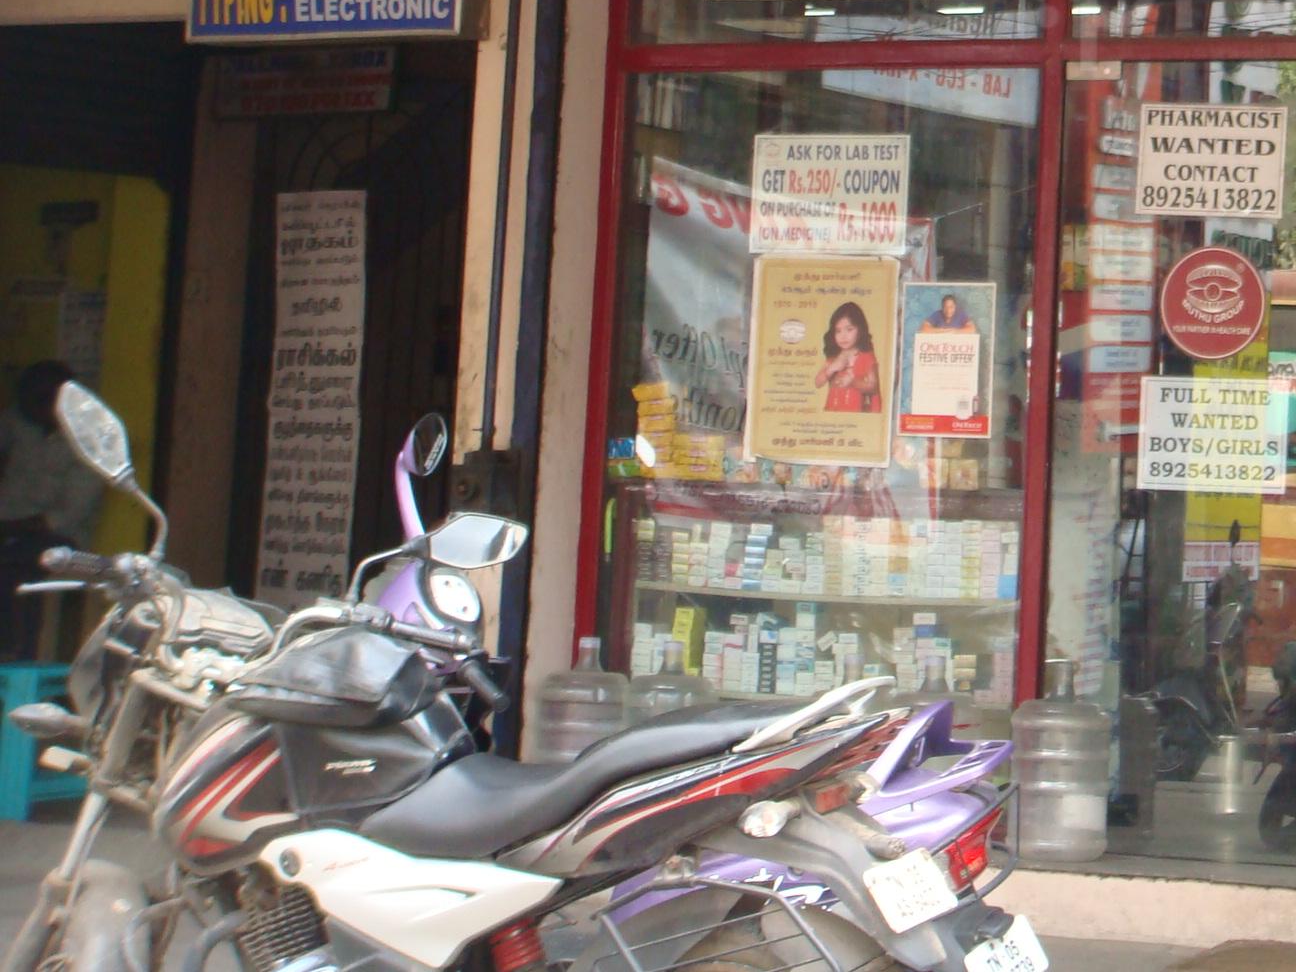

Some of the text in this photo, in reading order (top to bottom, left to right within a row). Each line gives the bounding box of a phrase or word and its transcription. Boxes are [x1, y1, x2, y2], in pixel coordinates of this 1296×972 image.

[1147, 109, 1282, 129] PHARMACIST
[787, 145, 900, 160] ASK FOR LAB TEST
[1150, 136, 1276, 156] WANTED
[762, 170, 786, 193] GET
[844, 170, 901, 194] COUPON
[1163, 164, 1259, 183] CONTACT
[1142, 186, 1276, 211] 8925413822
[1160, 387, 1271, 406] FULL TIME
[1171, 413, 1259, 430] WANTED
[1149, 437, 1279, 457] BOYS/GIRLS
[1149, 462, 1276, 481] 8925413822
